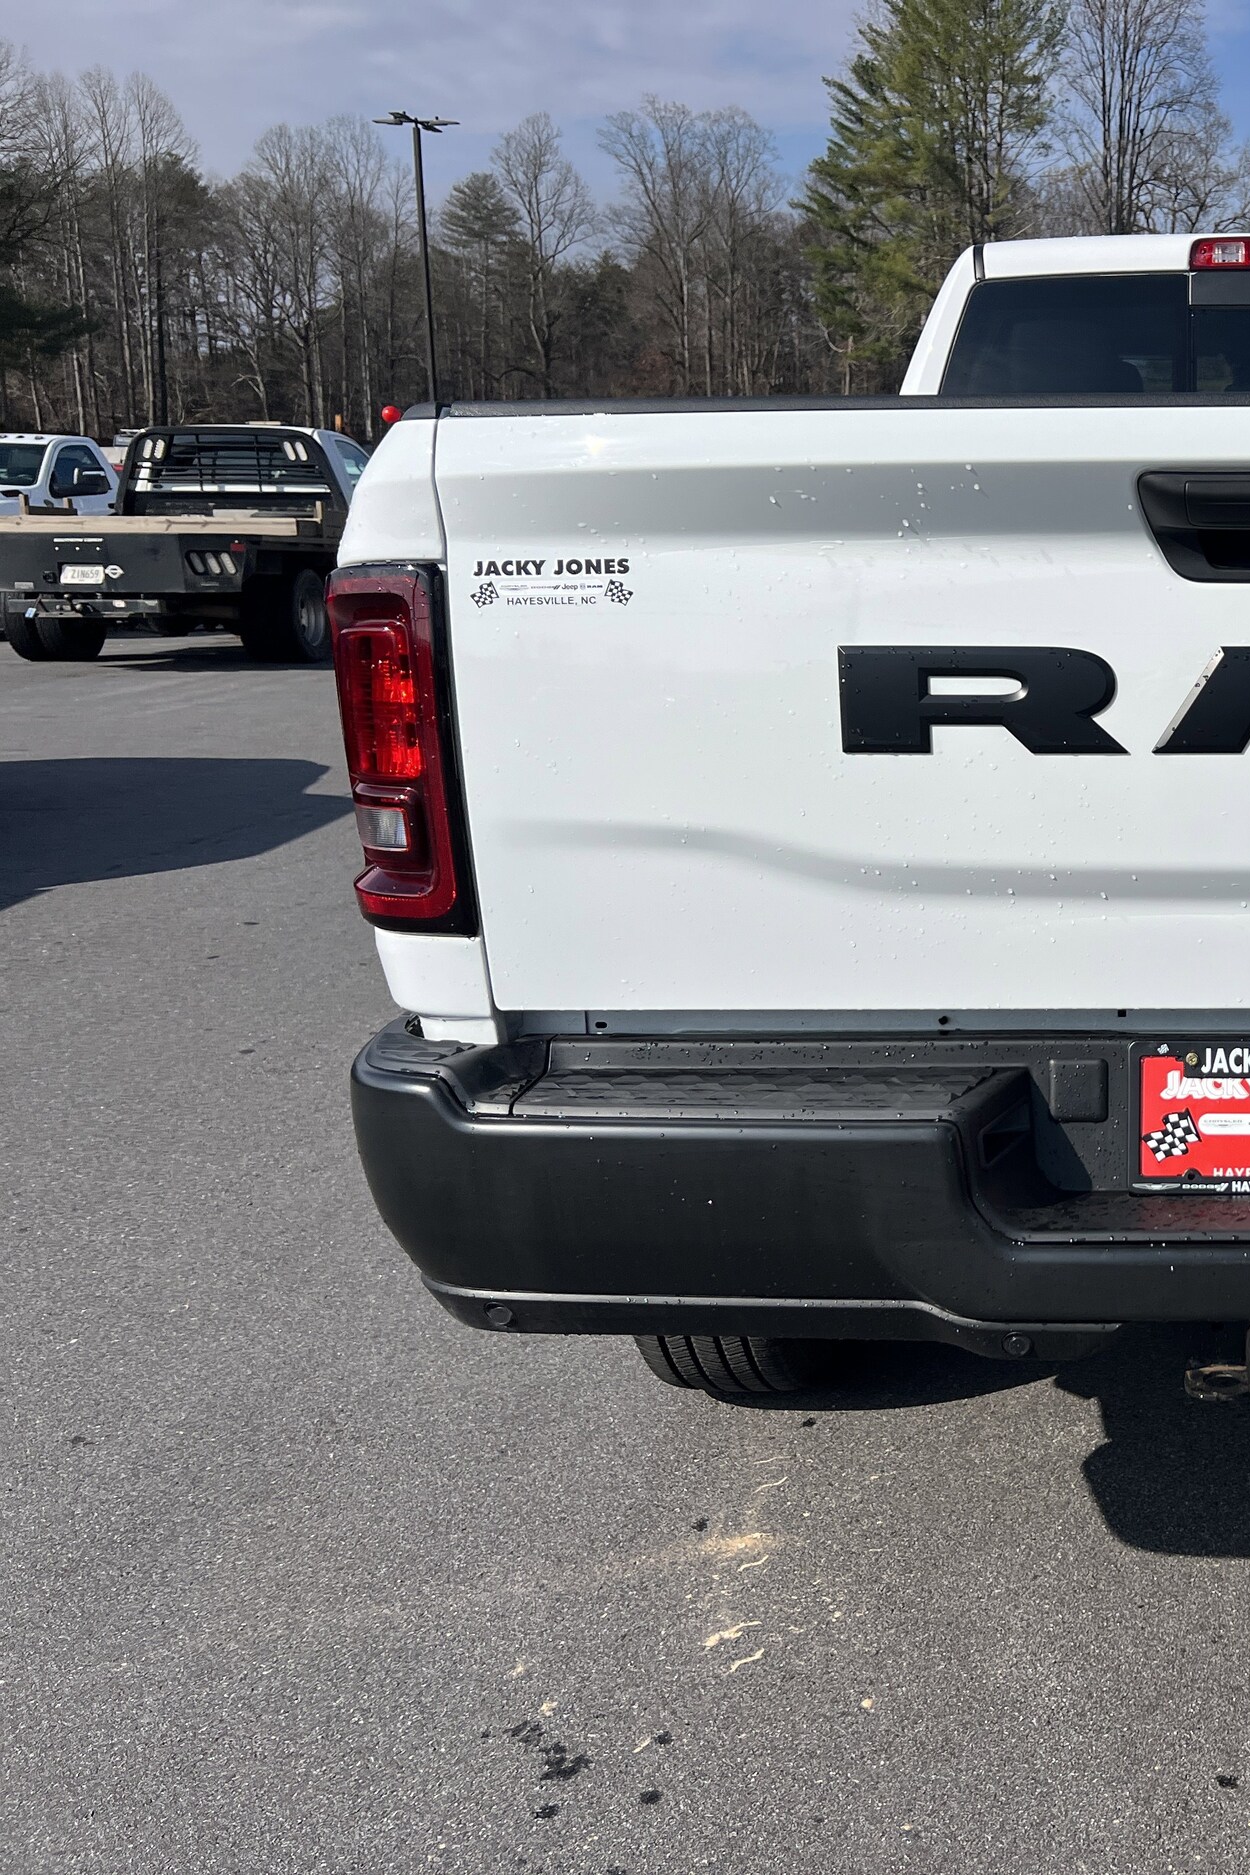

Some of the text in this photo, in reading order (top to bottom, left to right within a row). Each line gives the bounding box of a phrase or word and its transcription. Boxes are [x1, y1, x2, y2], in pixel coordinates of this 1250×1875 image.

[473, 558, 630, 576] JACKY JONES
[506, 596, 597, 606] HAYESVILLE, NC
